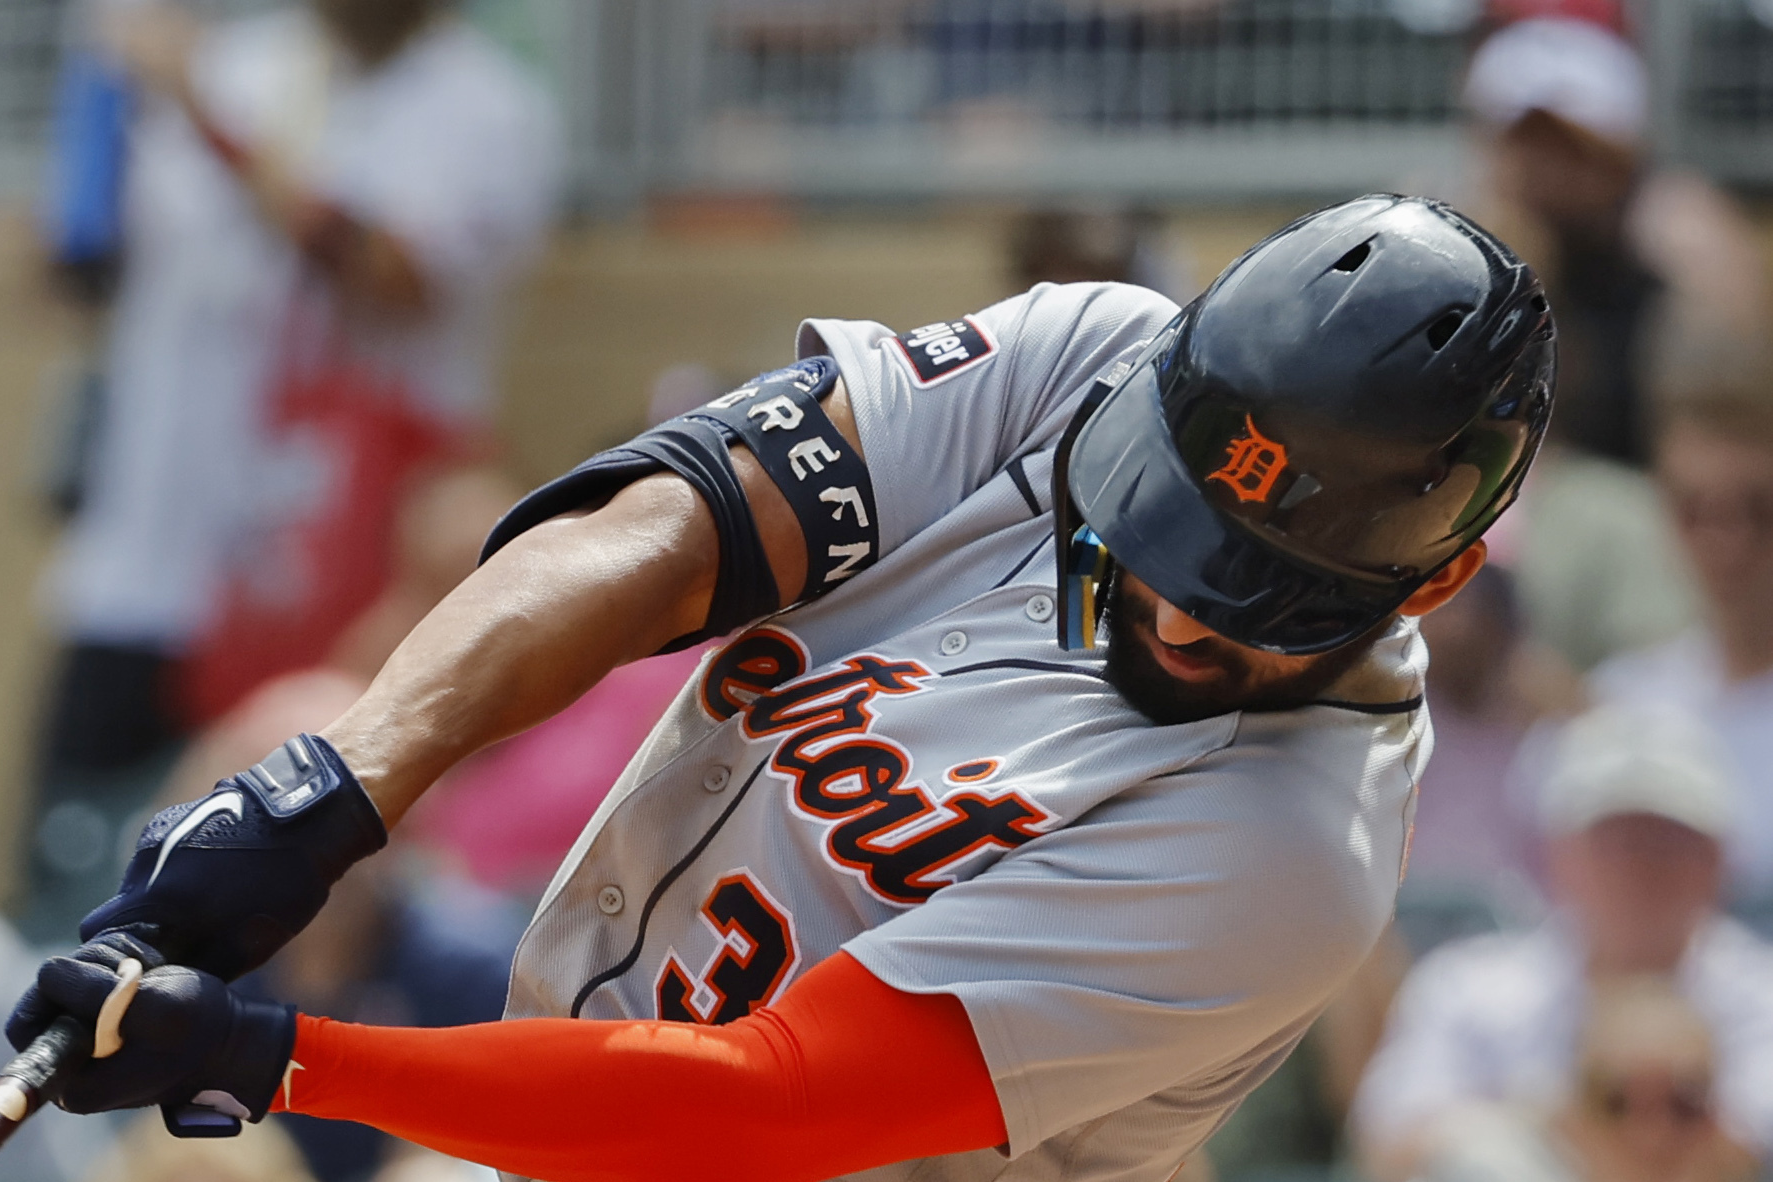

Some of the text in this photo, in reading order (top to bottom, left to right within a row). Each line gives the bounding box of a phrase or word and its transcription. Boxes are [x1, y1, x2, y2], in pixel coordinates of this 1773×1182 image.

[907, 321, 970, 366] eijer
[1205, 413, 1288, 502] D
[700, 627, 1061, 908] etroit
[654, 867, 802, 1025] 3
